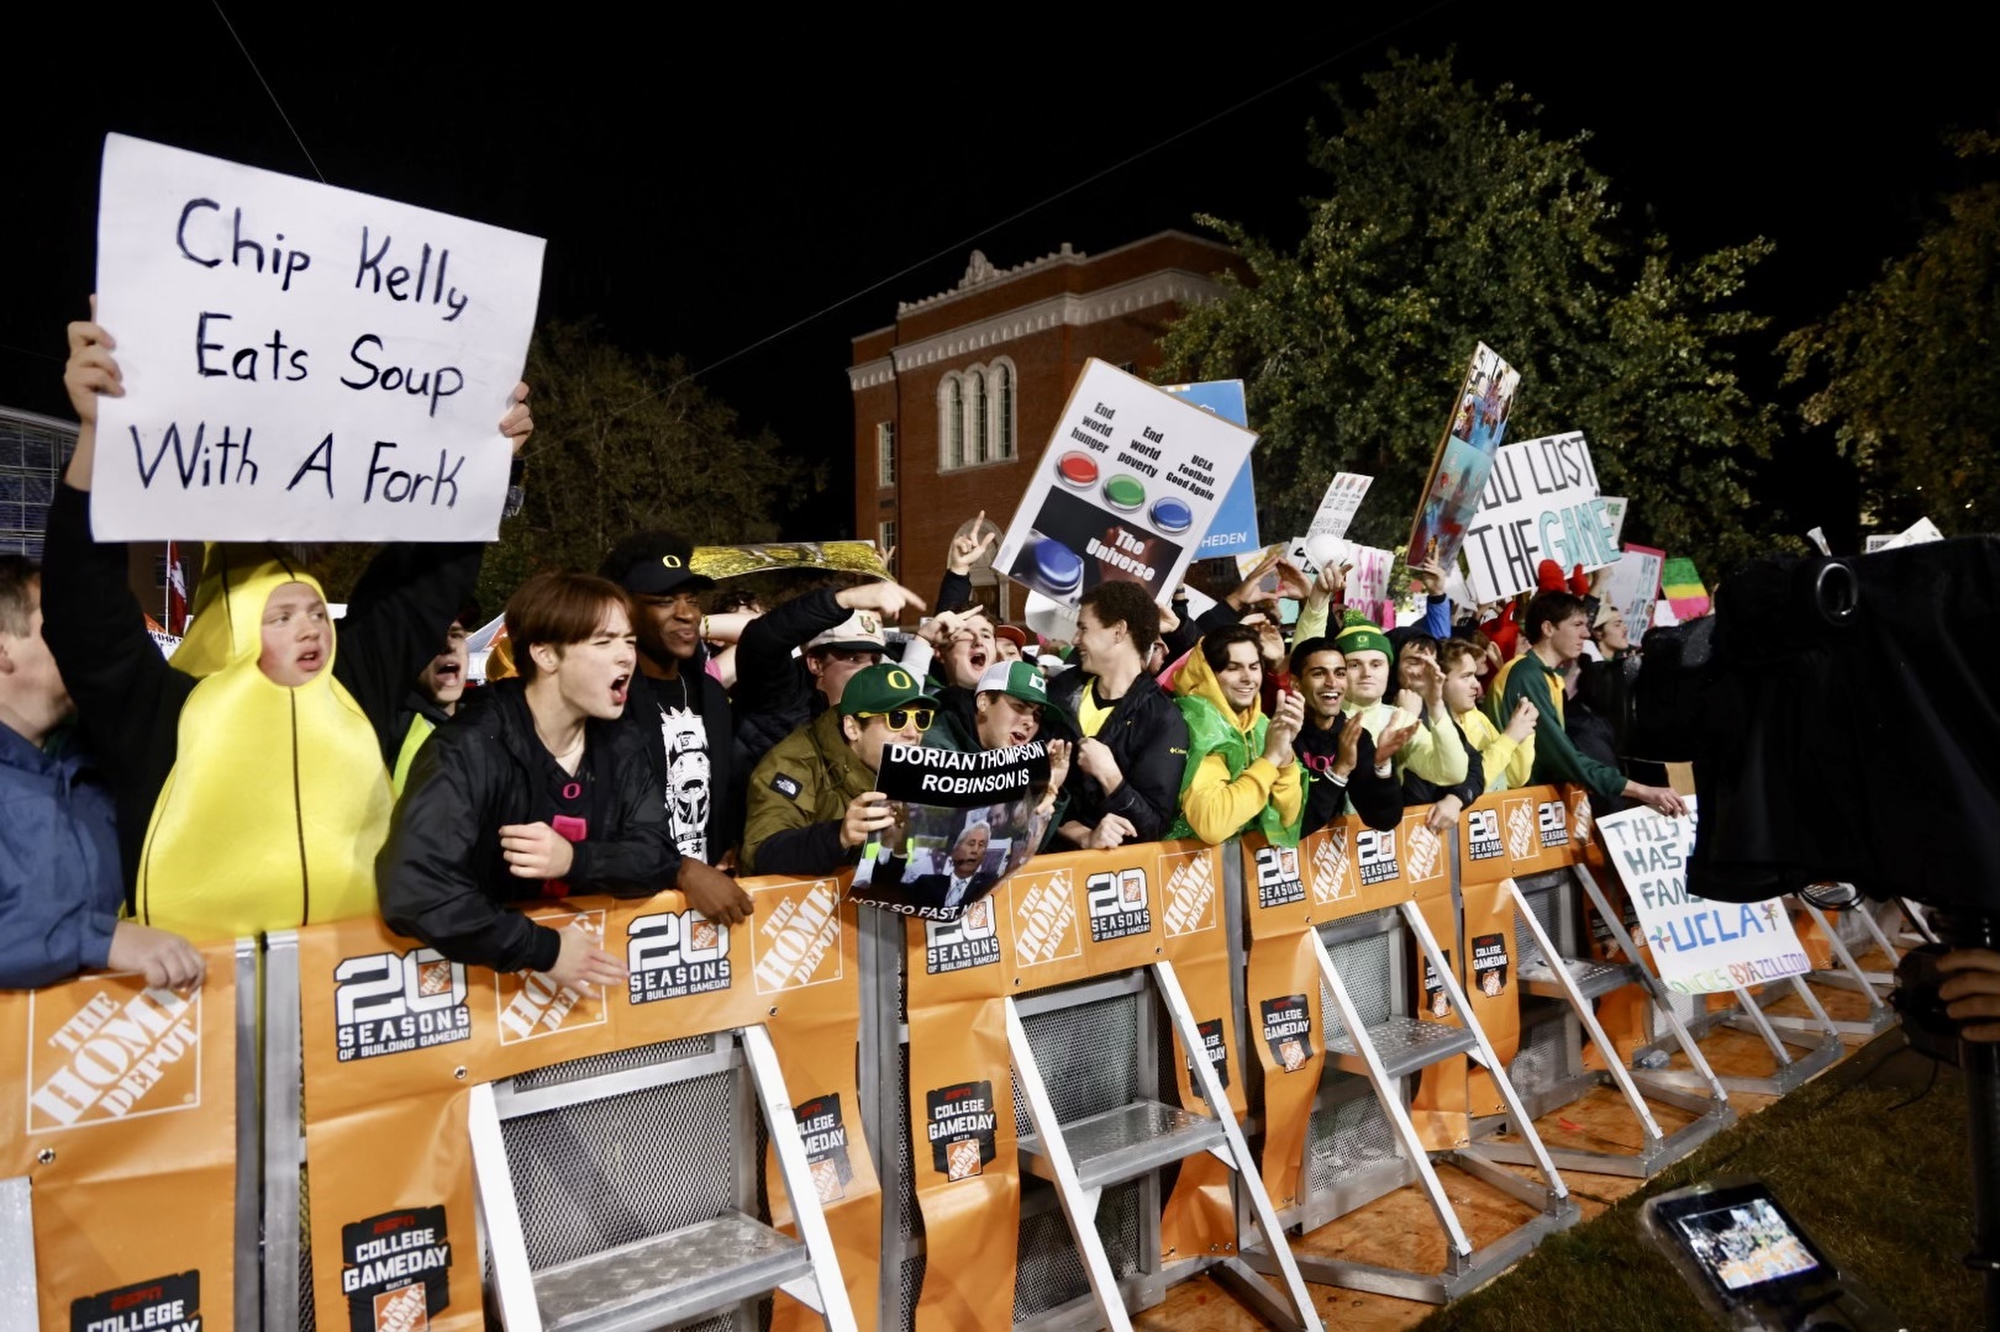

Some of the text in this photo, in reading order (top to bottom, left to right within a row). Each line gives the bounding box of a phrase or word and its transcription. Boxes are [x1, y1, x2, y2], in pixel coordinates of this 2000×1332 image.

[176, 197, 468, 321] Chip Kelly
[196, 312, 464, 418] Eats Soup
[1094, 402, 1116, 420] End
[1070, 427, 1109, 454] hunger
[1081, 415, 1113, 438] world
[1142, 425, 1164, 444] End
[129, 421, 465, 508] With A Fork
[1116, 450, 1159, 478] poverty
[1130, 438, 1161, 461] world
[1190, 454, 1214, 472] UCLA
[1165, 472, 1215, 502] Good Again
[1177, 463, 1215, 487] Football
[1113, 528, 1146, 556] The
[1467, 499, 1622, 597] THE GAME
[662, 554, 682, 569] O
[1085, 537, 1156, 582] Universe
[887, 670, 912, 690] O
[890, 741, 1046, 771] DORIAN THOMPSON
[562, 782, 581, 799] O
[921, 768, 1030, 795] ROBINSON IS
[1468, 809, 1499, 843] 20
[1538, 801, 1566, 832] 20
[1603, 815, 1680, 845] THIS
[1356, 829, 1396, 866] 20
[1469, 840, 1503, 854] SEASONS
[1540, 829, 1568, 842] SEASONS
[1256, 847, 1300, 888] 20
[1360, 861, 1398, 878] SEASONS
[1623, 842, 1682, 876] HAS
[1086, 867, 1148, 919] 20
[1164, 850, 1212, 935] HOME
[1165, 862, 1187, 895] THE
[1259, 880, 1304, 900] SEASONS
[848, 896, 889, 909] NOT
[890, 903, 916, 915] SO
[1016, 883, 1043, 920] THE
[1016, 868, 1074, 965] HOME
[1186, 877, 1214, 932] DEPOT
[760, 896, 797, 939] THE
[1041, 901, 1076, 960] DEPOT
[1091, 910, 1150, 933] SEASONS
[1667, 903, 1765, 952] UCLA
[627, 908, 731, 972] 20
[755, 880, 839, 990] HOME
[794, 915, 840, 985] DEPOT
[928, 938, 999, 965] SEASONS
[1473, 954, 1508, 970] GAMEDAY
[1475, 945, 1502, 957] COLLEGE
[335, 948, 468, 1026] 20
[630, 960, 731, 992] SEASONS
[631, 978, 730, 1005] OF BUILDING GAMEDAY
[47, 991, 121, 1053] THE
[338, 1007, 469, 1048] SEASONS
[1264, 1020, 1310, 1040] GAMEDAY
[1267, 1009, 1303, 1024] COLLEGE
[339, 1027, 470, 1061] OF BUILDING GAMEDAY
[98, 1018, 199, 1118] DEPOT
[798, 1113, 836, 1136] LLEGE
[935, 1099, 985, 1120] COLLEGE
[804, 1128, 845, 1156] MEDAY
[928, 1114, 994, 1140] GAMEDAY
[356, 1228, 436, 1263] COLLEGE
[343, 1246, 448, 1293] GAMEDAY
